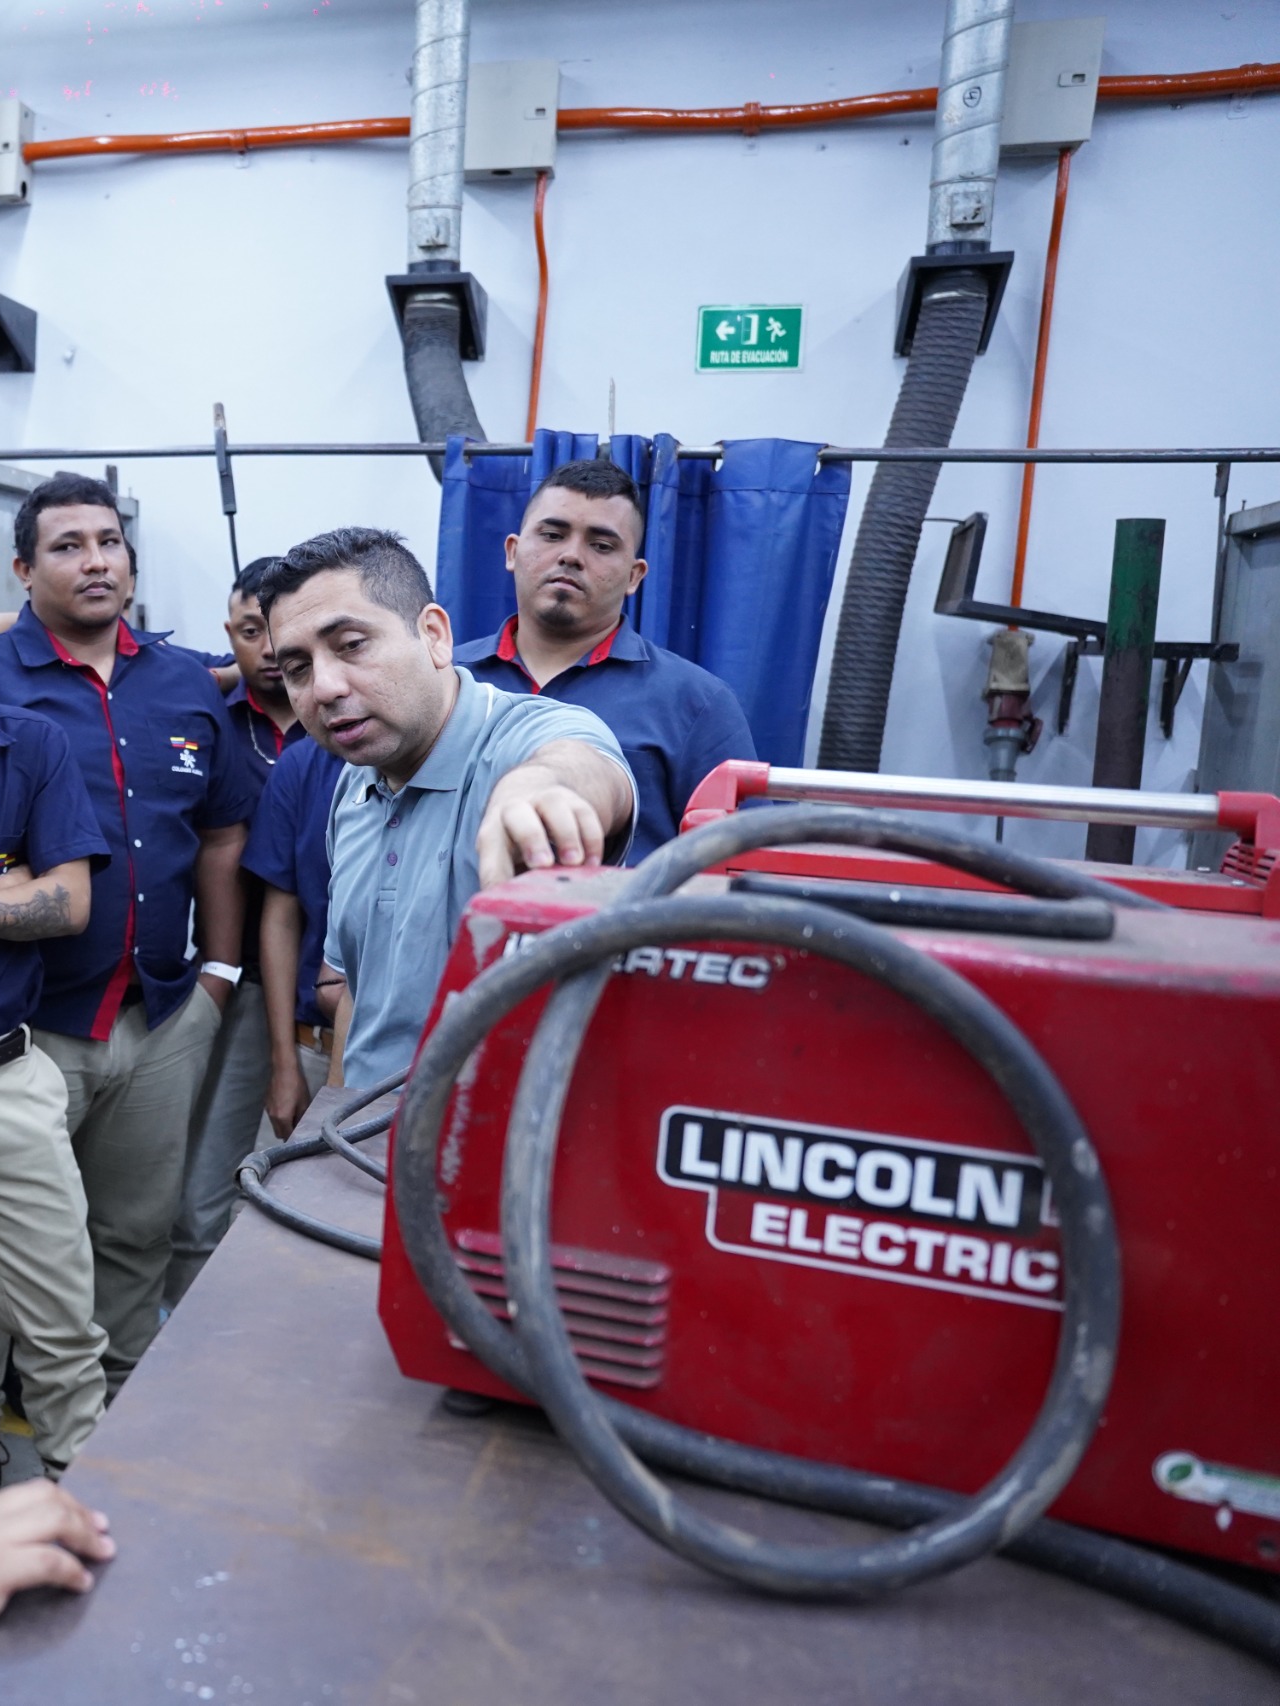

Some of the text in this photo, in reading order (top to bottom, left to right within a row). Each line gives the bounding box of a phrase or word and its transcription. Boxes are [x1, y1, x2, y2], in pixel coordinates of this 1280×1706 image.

[710, 347, 789, 364] RUTA DE EVACUACIÓN
[680, 1121, 1024, 1228] LINCOLN
[750, 1202, 1060, 1292] ELECTRIC
